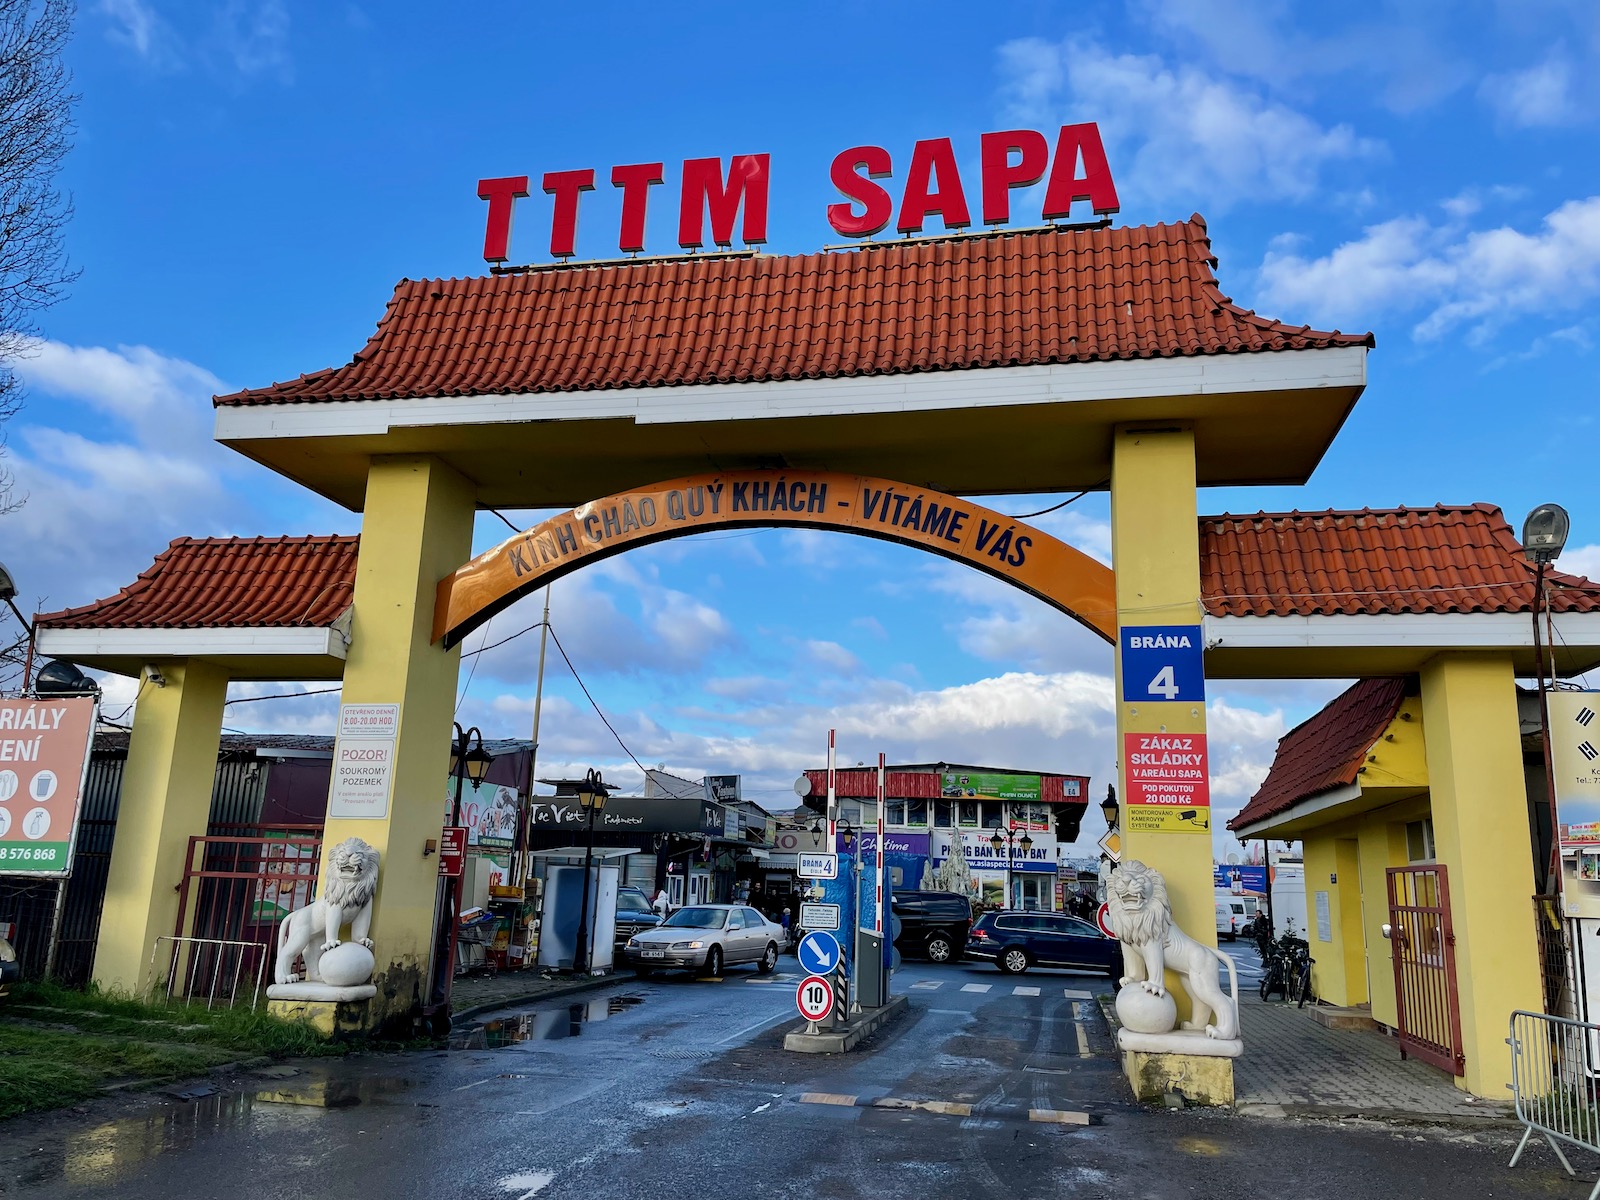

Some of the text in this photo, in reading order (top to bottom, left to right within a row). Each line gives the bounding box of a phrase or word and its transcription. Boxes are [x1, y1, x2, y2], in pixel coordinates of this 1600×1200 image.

[477, 122, 1120, 262] TTTM SAPA
[508, 522, 578, 577] KÍNH
[583, 497, 656, 543] CHÀO
[666, 478, 724, 522] QUÝ
[732, 476, 828, 514] KHÁCH
[863, 487, 970, 544] VÍTÁME
[974, 518, 1033, 568] VÁS
[1130, 634, 1192, 649] BRÁNA
[1147, 665, 1180, 700] 4
[344, 717, 394, 725] 8.00-20.00 HOD.
[1140, 736, 1193, 750] ZÁKAZ
[341, 749, 388, 762] POZOR!
[1131, 752, 1203, 766] SKLÁDKY
[340, 766, 387, 775] SOUKROMÝ
[1133, 768, 1203, 778] V AREÁLU SAPA
[342, 778, 382, 786] POZEMEK
[1142, 784, 1194, 793] POD POKUTOU
[1068, 788, 1076, 796] E4
[1146, 794, 1192, 804] 20 000 Kč
[861, 838, 909, 851] Chtime
[9, 848, 31, 860] 576
[33, 849, 56, 861] 868
[974, 844, 993, 858] BÁN
[1030, 848, 1048, 859] BAY
[802, 859, 832, 874] BRÁNA 4
[807, 986, 823, 1004] 10
